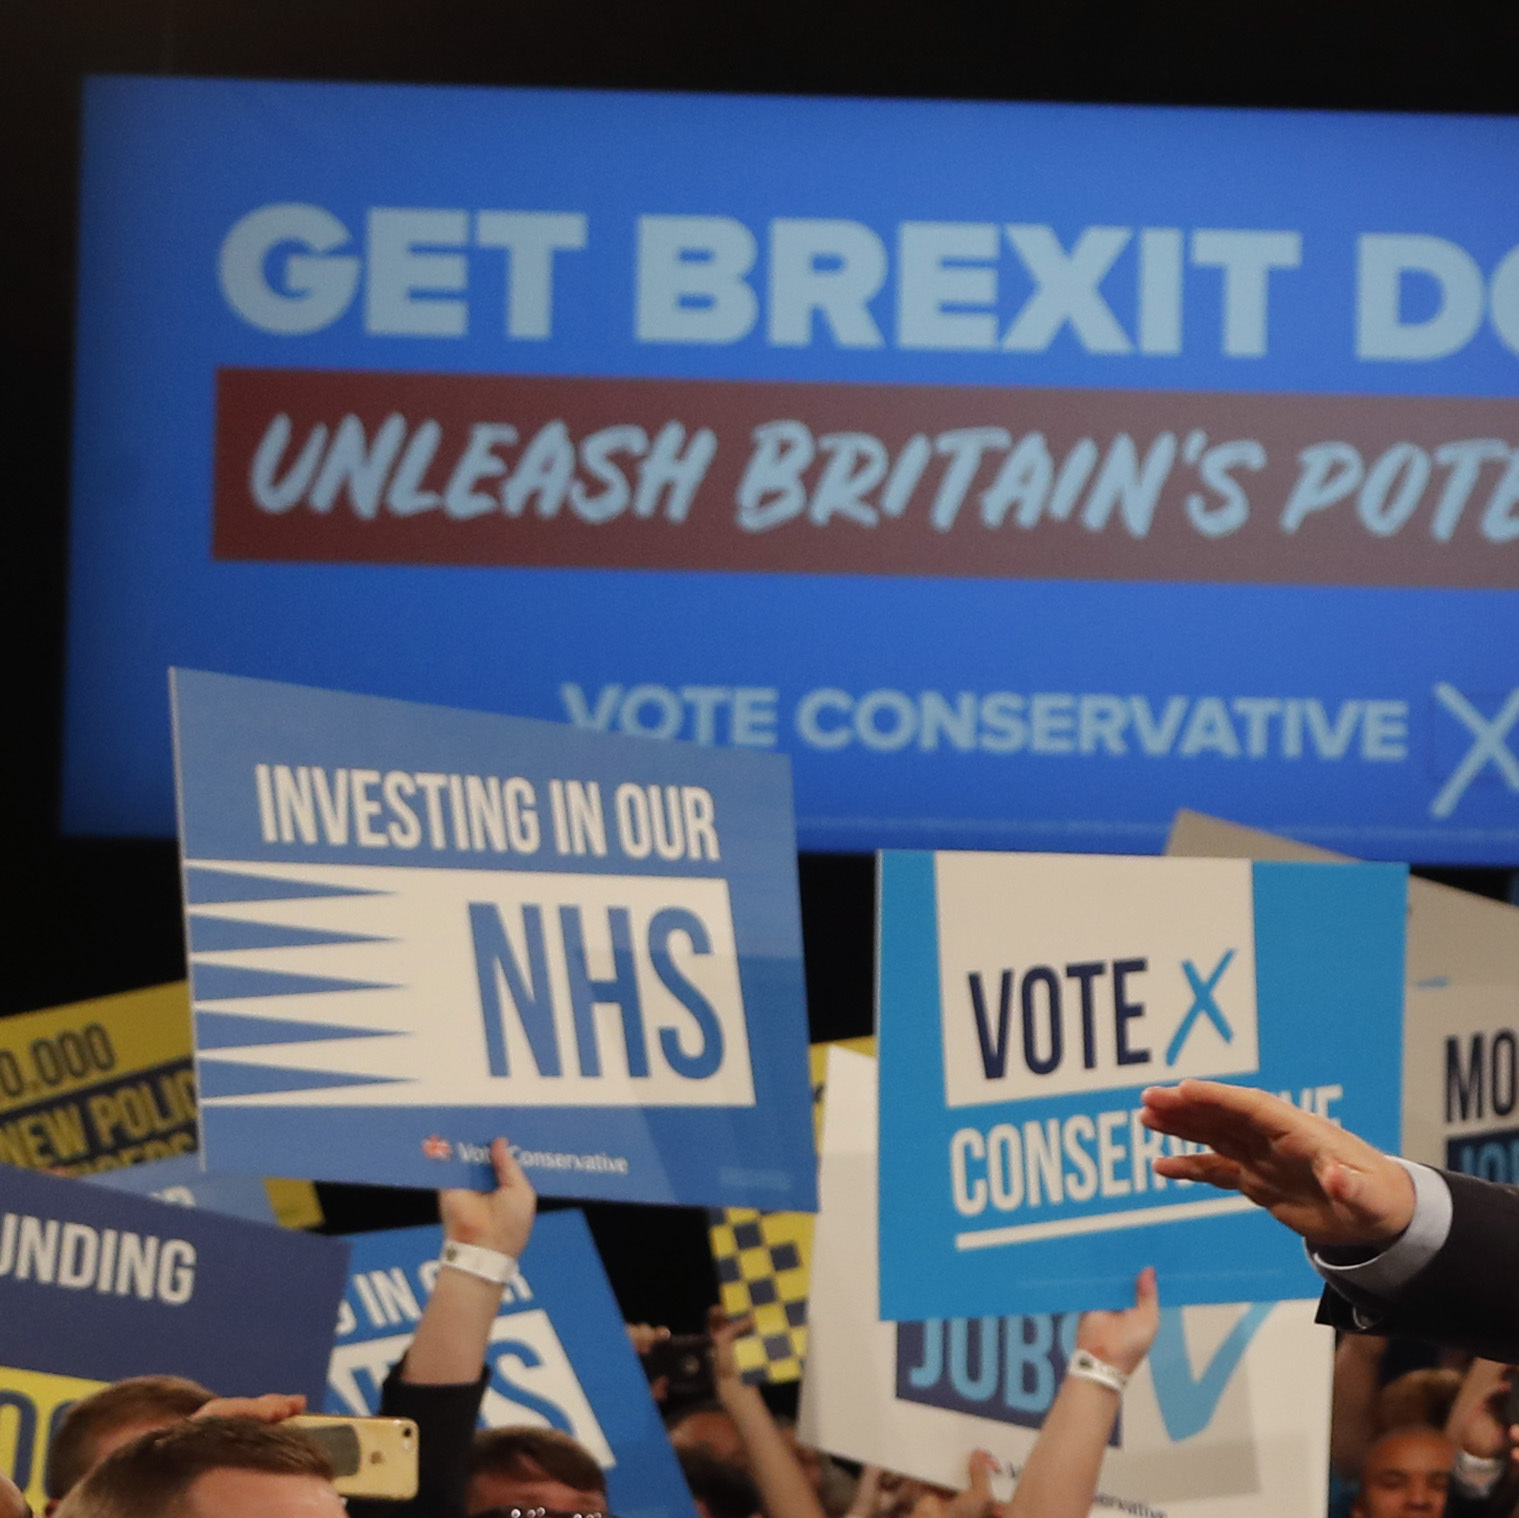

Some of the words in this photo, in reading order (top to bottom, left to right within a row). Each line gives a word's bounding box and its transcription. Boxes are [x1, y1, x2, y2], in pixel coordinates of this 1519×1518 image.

[218, 203, 588, 341] GET
[635, 214, 1302, 358] BREXIT
[250, 413, 718, 522] UNLEASH
[736, 420, 1266, 540] BRITAIN'S
[560, 683, 778, 747] VOTE
[796, 690, 1409, 762] CONSERVATIVE
[256, 763, 540, 854] INVESTING
[550, 779, 610, 857] IN
[614, 784, 722, 863] OUR
[466, 901, 725, 1080] NHS
[968, 957, 1151, 1080] VOTE
[457, 1141, 493, 1165] Vot
